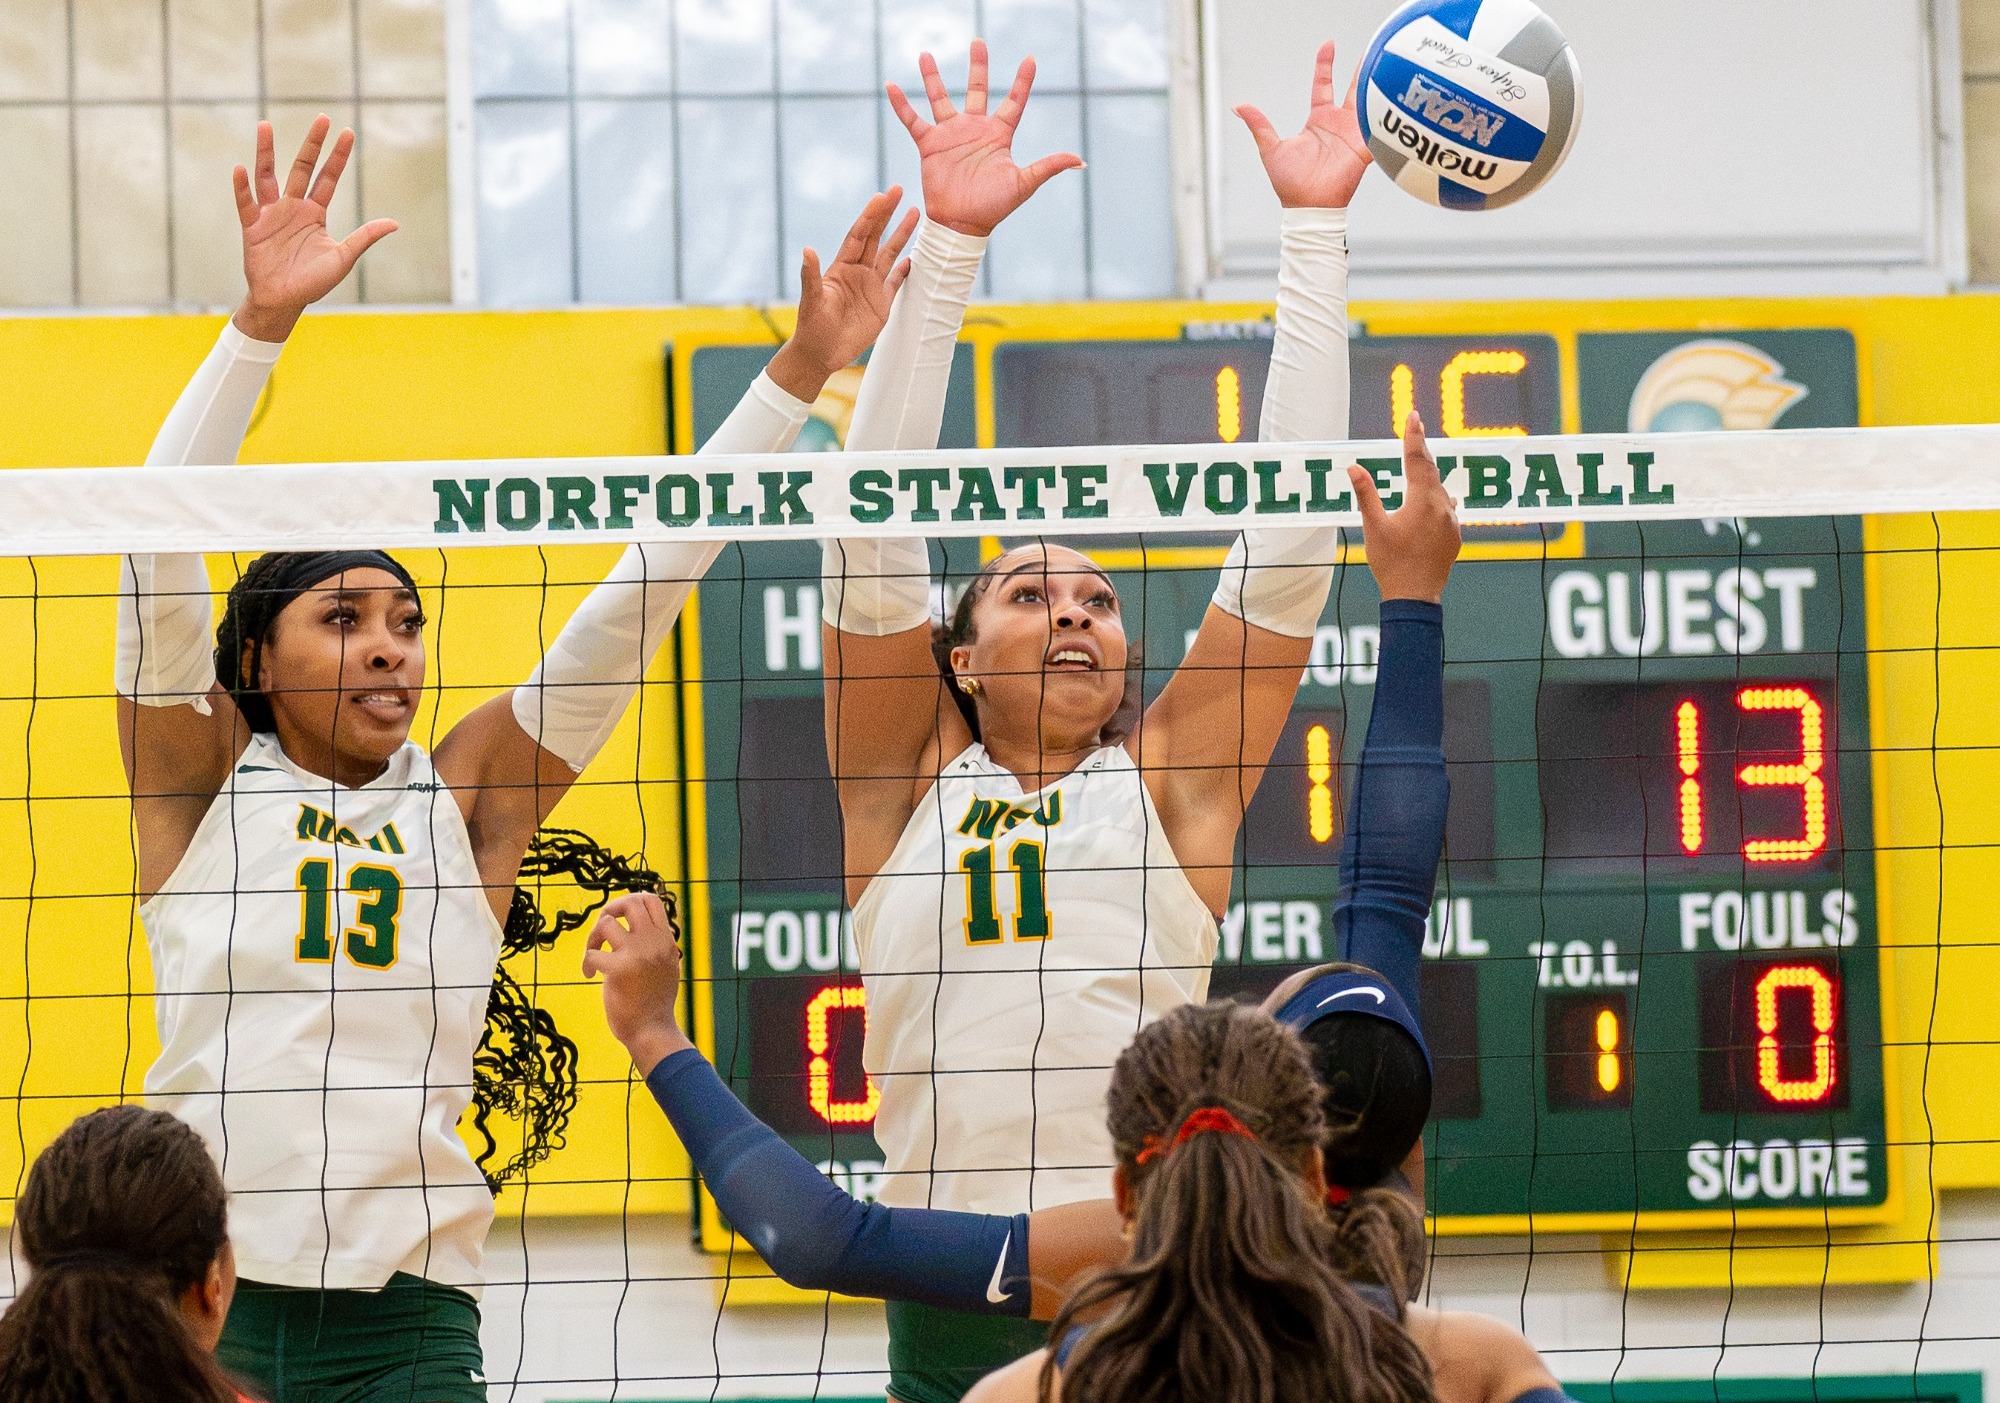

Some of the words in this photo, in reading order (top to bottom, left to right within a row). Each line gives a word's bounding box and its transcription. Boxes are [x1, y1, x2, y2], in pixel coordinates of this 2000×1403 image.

[1417, 36, 1473, 69] Touch
[1477, 63, 1526, 102] Super
[1382, 107, 1499, 181] molten
[1401, 74, 1506, 148] NCAA
[432, 471, 814, 534] NORFOLK
[848, 464, 1110, 524] STATE
[1549, 567, 1817, 659] GUEST
[1306, 724, 1333, 843] 1
[1677, 688, 1827, 863] 13
[294, 857, 404, 971] 13
[959, 838, 1053, 946] 11
[1679, 889, 1859, 951] FOULS
[1528, 939, 1639, 987] T.O.L.
[1756, 966, 1836, 1102] 0
[1687, 1137, 1871, 1201] SCORE
